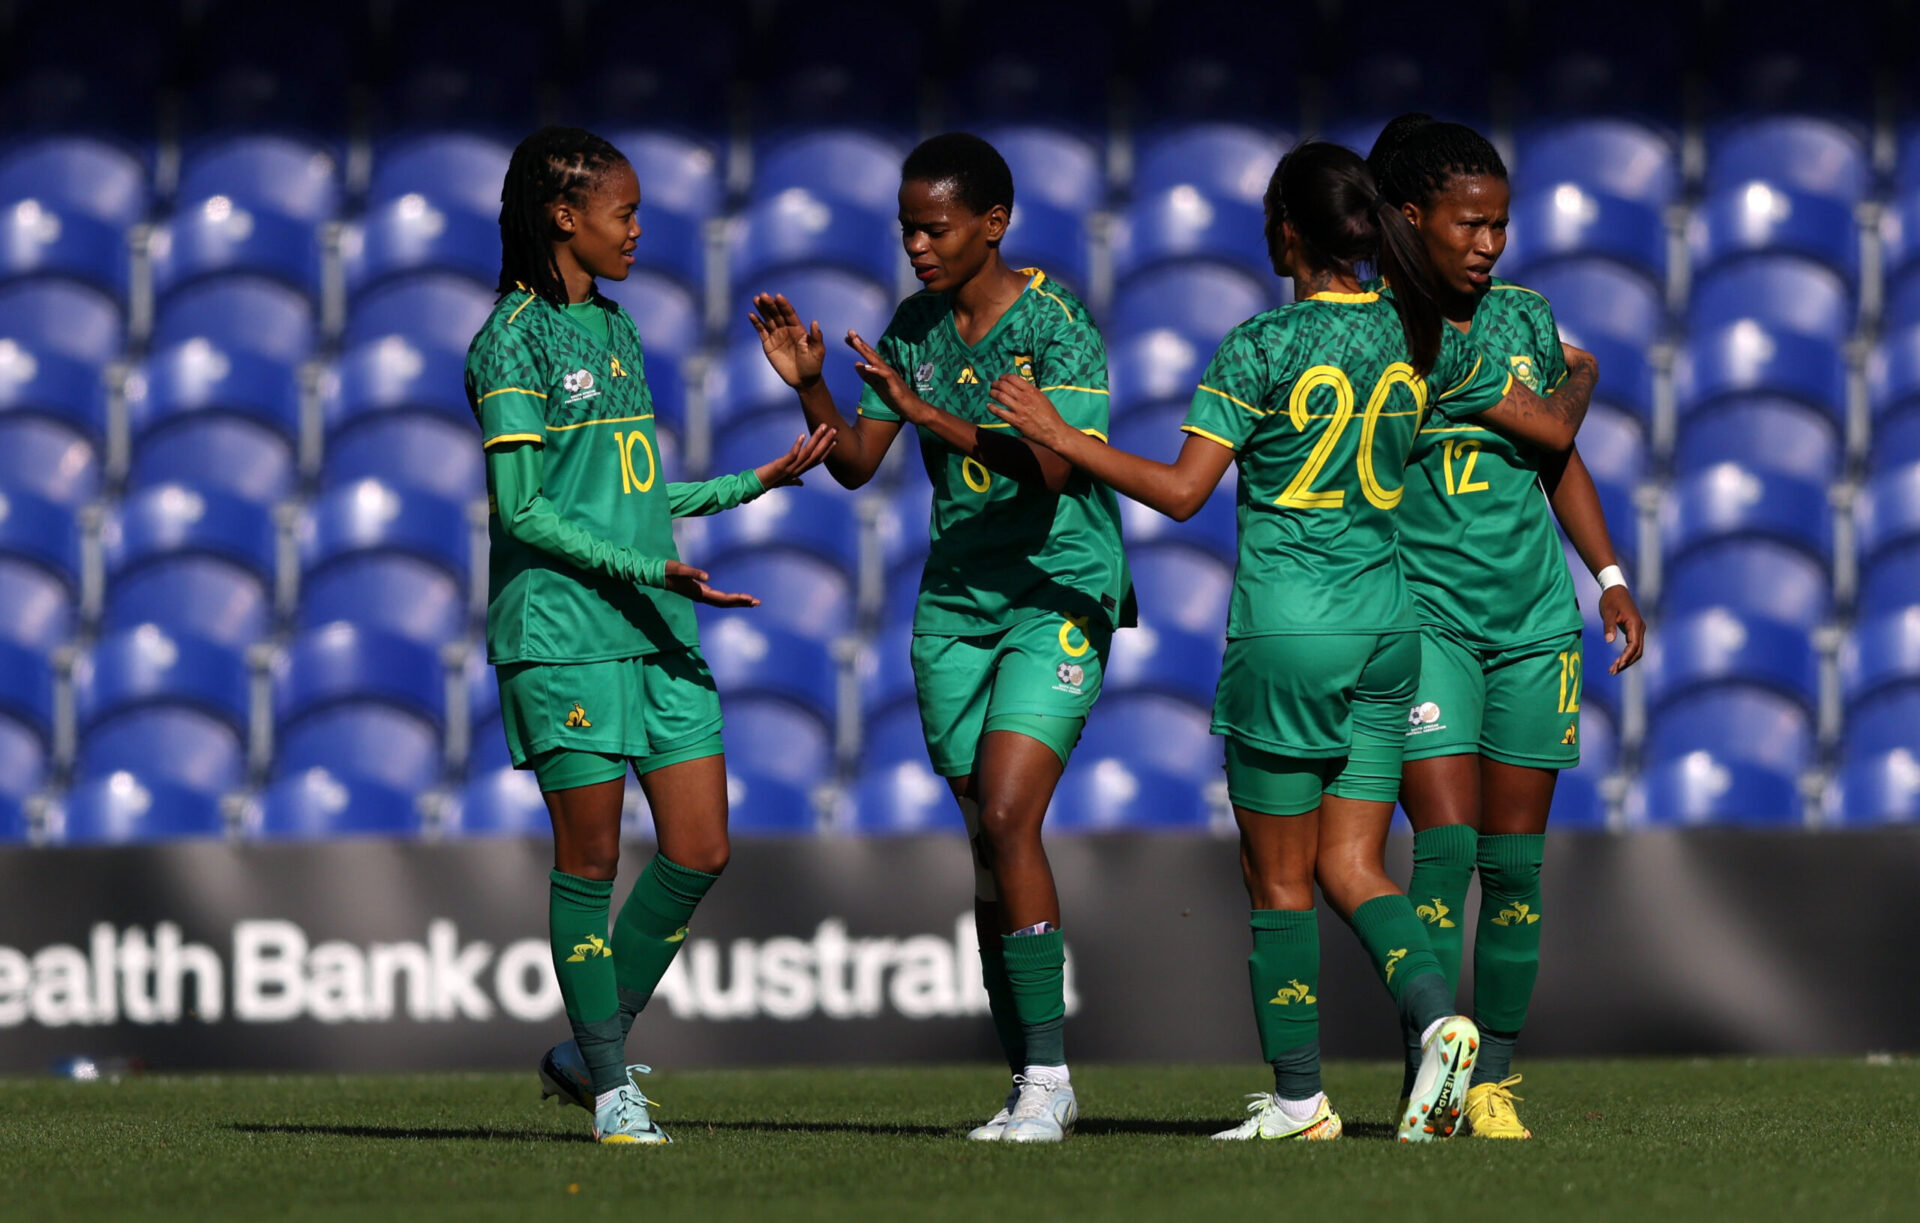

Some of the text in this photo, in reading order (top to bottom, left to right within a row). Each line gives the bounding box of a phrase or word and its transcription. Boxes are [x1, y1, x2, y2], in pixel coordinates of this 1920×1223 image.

[614, 430, 655, 494] 10
[1273, 361, 1428, 510] 20
[1441, 439, 1489, 496] 12
[1557, 651, 1581, 713] 12
[232, 917, 496, 1023] Bank
[495, 937, 567, 1022] o
[654, 913, 1081, 1022] ustral
